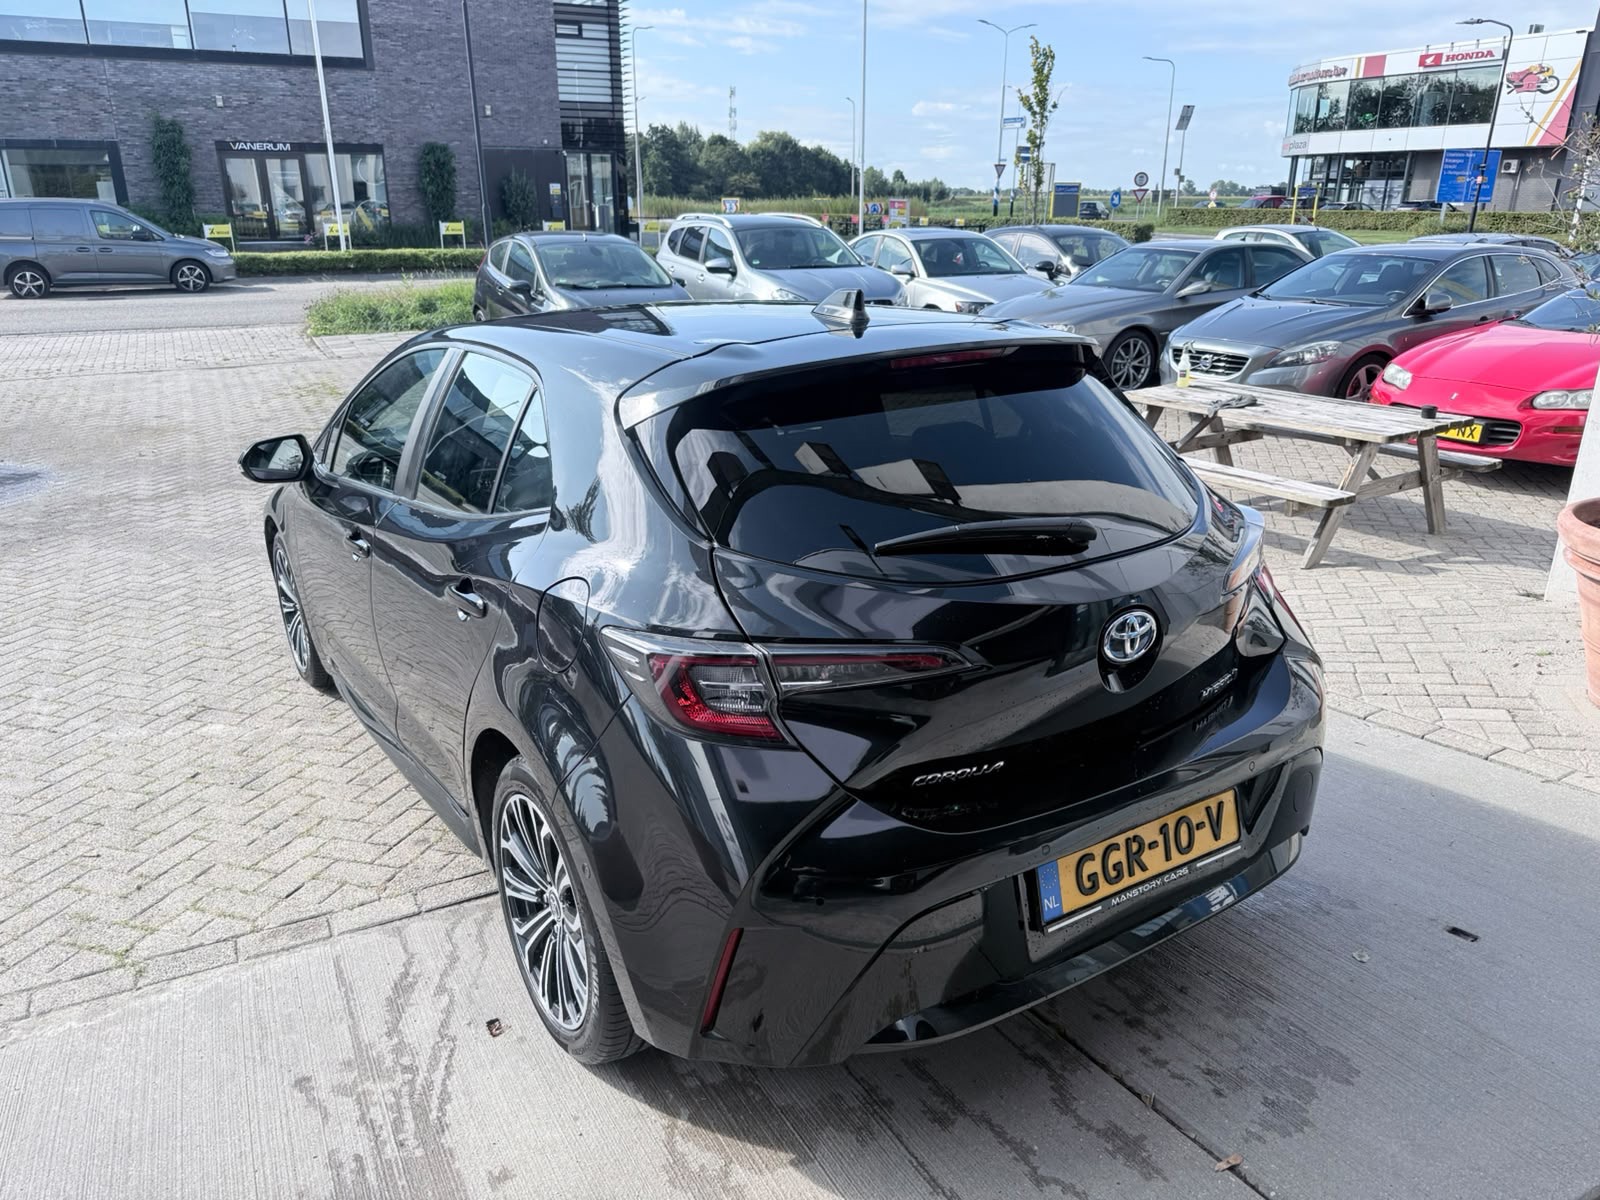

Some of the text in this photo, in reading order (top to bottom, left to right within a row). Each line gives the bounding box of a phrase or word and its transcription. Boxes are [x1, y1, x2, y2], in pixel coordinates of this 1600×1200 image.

[1444, 49, 1495, 62] HONDA
[230, 142, 291, 151] VANERUM
[1282, 139, 1307, 152] plaza
[911, 761, 1005, 786] COROLLA
[1075, 801, 1225, 896] GGR-10-V
[1111, 867, 1190, 906] MANSTORY CARS
[1043, 895, 1060, 911] NL
